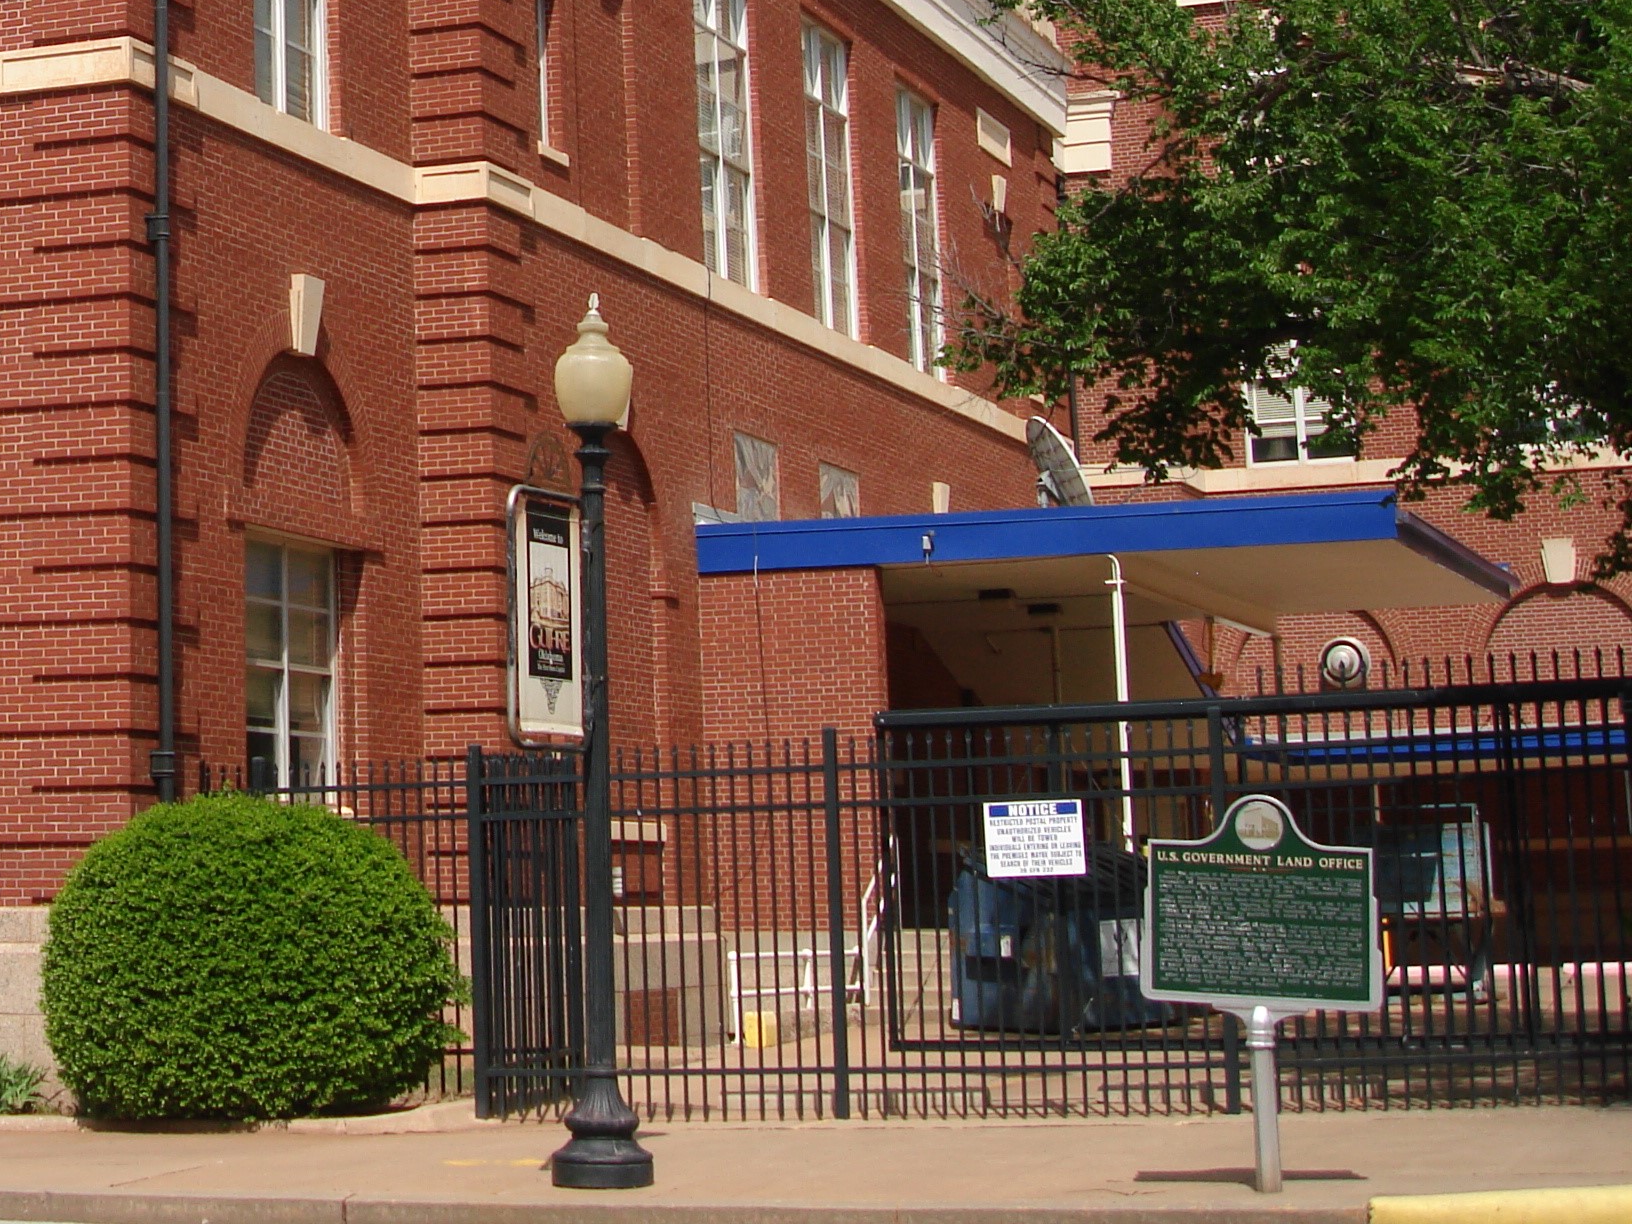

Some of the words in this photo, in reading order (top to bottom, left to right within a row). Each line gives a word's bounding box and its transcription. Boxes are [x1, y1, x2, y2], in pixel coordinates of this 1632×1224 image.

[1008, 803, 1057, 816] NOTICE
[997, 827, 1041, 835] UNAUTHORIZED
[1157, 851, 1179, 861] U.S.
[1183, 852, 1271, 866] GOVERNMENT
[1277, 856, 1313, 867] LAND
[1319, 858, 1363, 870] OFFICE
